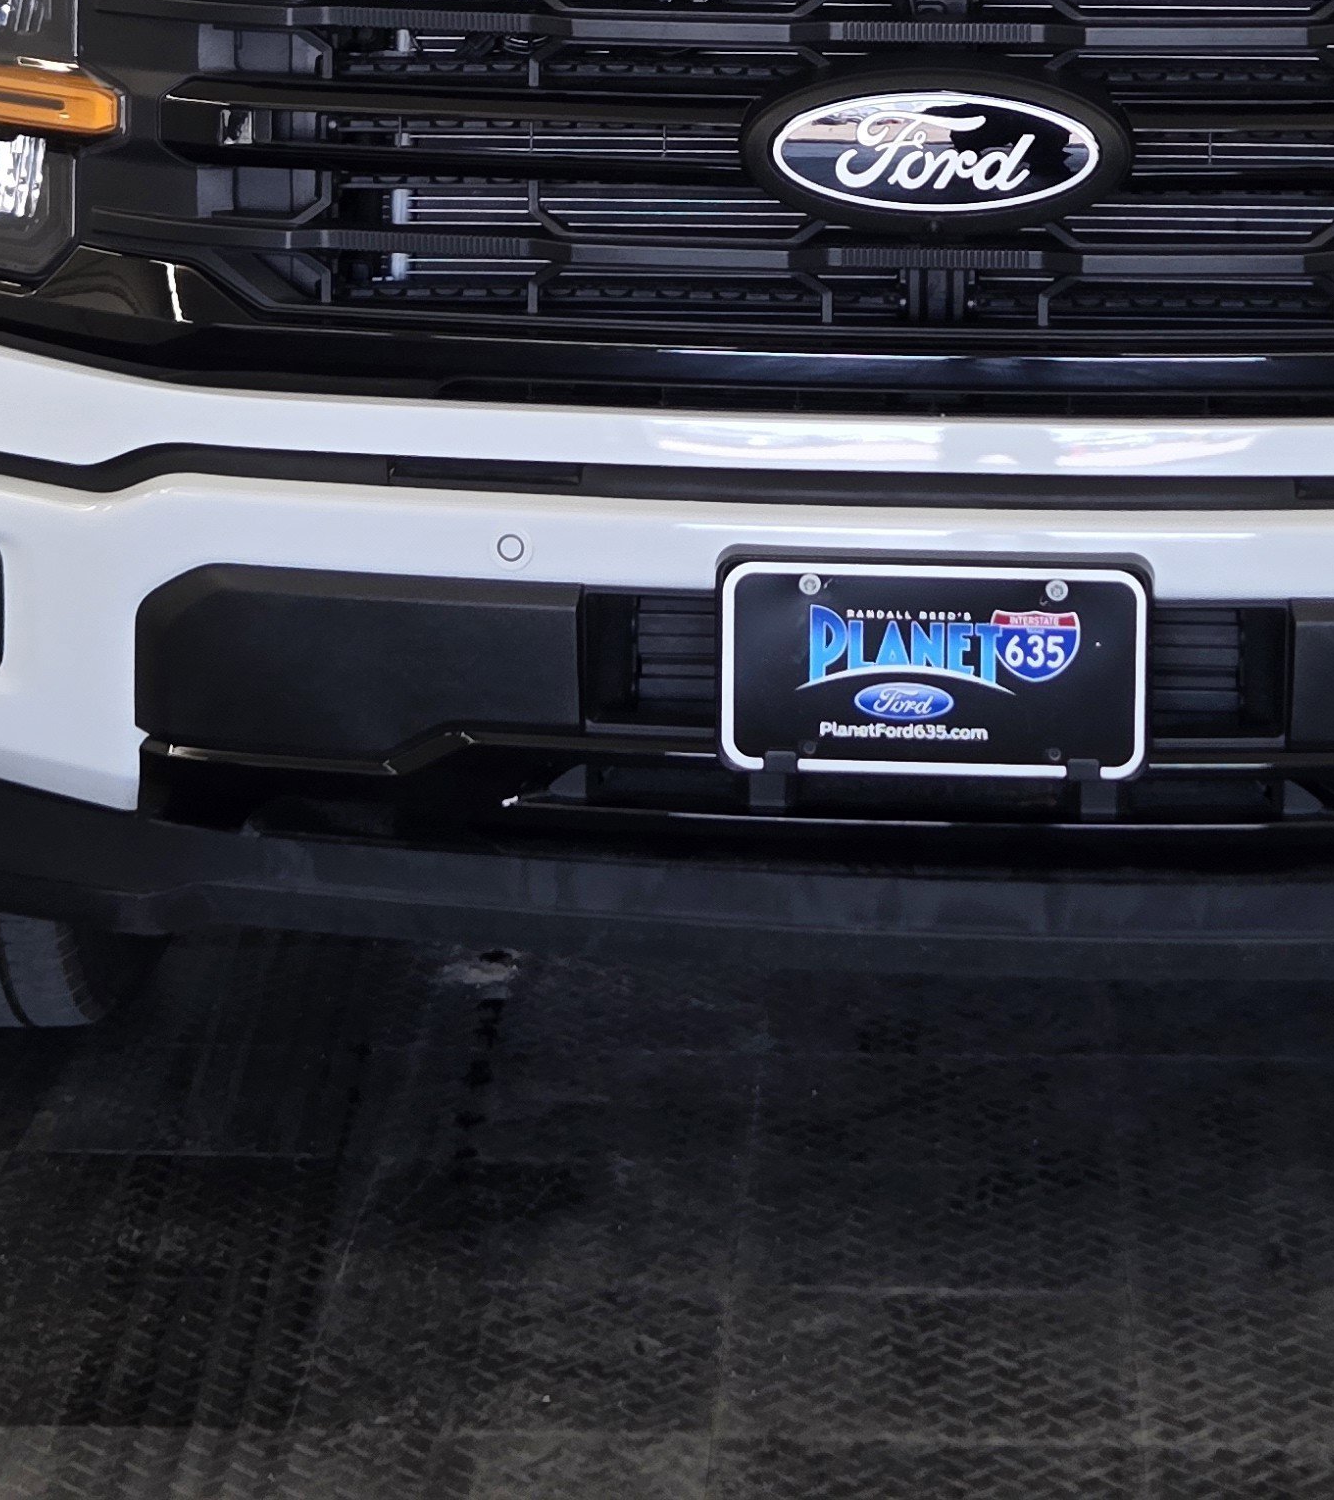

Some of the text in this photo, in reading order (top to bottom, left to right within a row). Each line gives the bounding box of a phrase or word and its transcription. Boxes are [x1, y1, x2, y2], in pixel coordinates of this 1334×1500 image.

[835, 110, 1035, 191] Ford
[846, 609, 912, 620] RANDALL
[1009, 616, 1059, 626] INTERSTATE
[809, 604, 1002, 684] PLANET
[1005, 635, 1065, 668] 635
[872, 687, 934, 714] Ford
[819, 721, 989, 741] PlanetFord635.com
